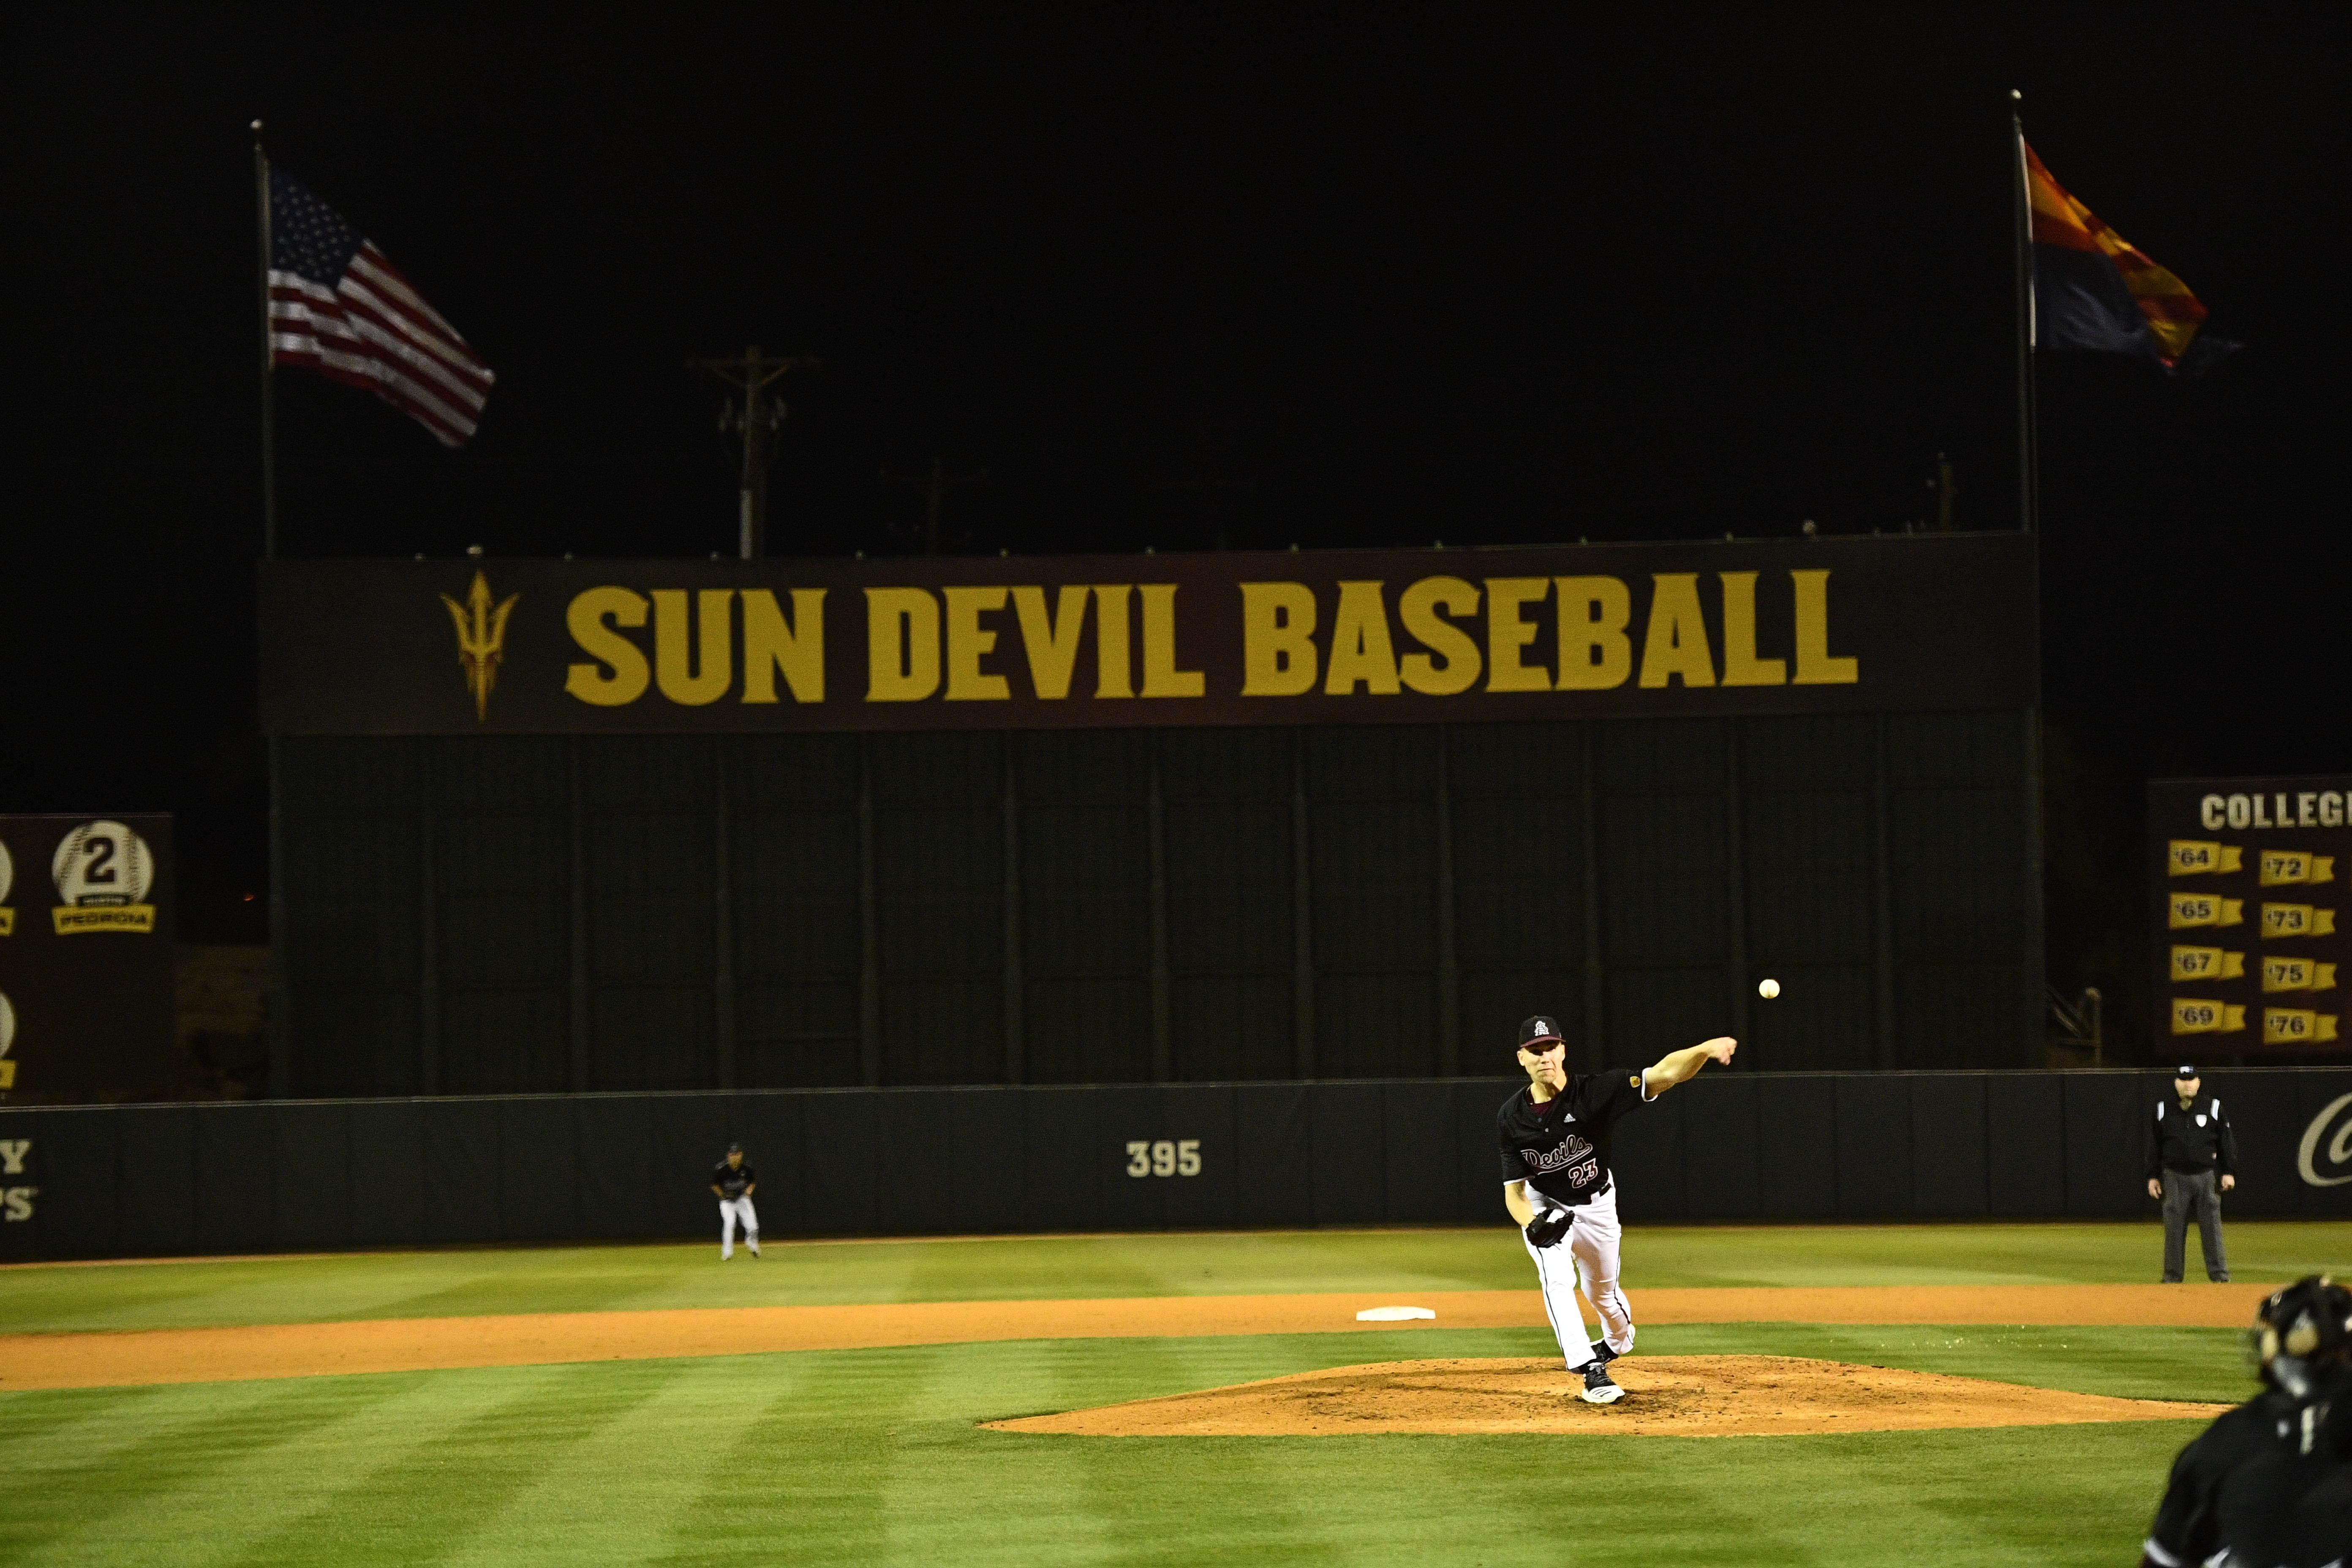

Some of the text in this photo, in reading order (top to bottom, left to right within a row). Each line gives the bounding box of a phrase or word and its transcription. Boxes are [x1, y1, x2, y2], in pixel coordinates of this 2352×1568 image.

[564, 569, 1858, 706] SUN DEVIL BASEBALL
[2200, 789, 2352, 831] COLLEG
[83, 837, 115, 882] 2
[1126, 1139, 1202, 1178] 395
[1520, 1134, 1593, 1175] Devils
[1568, 1157, 1598, 1189] 23
